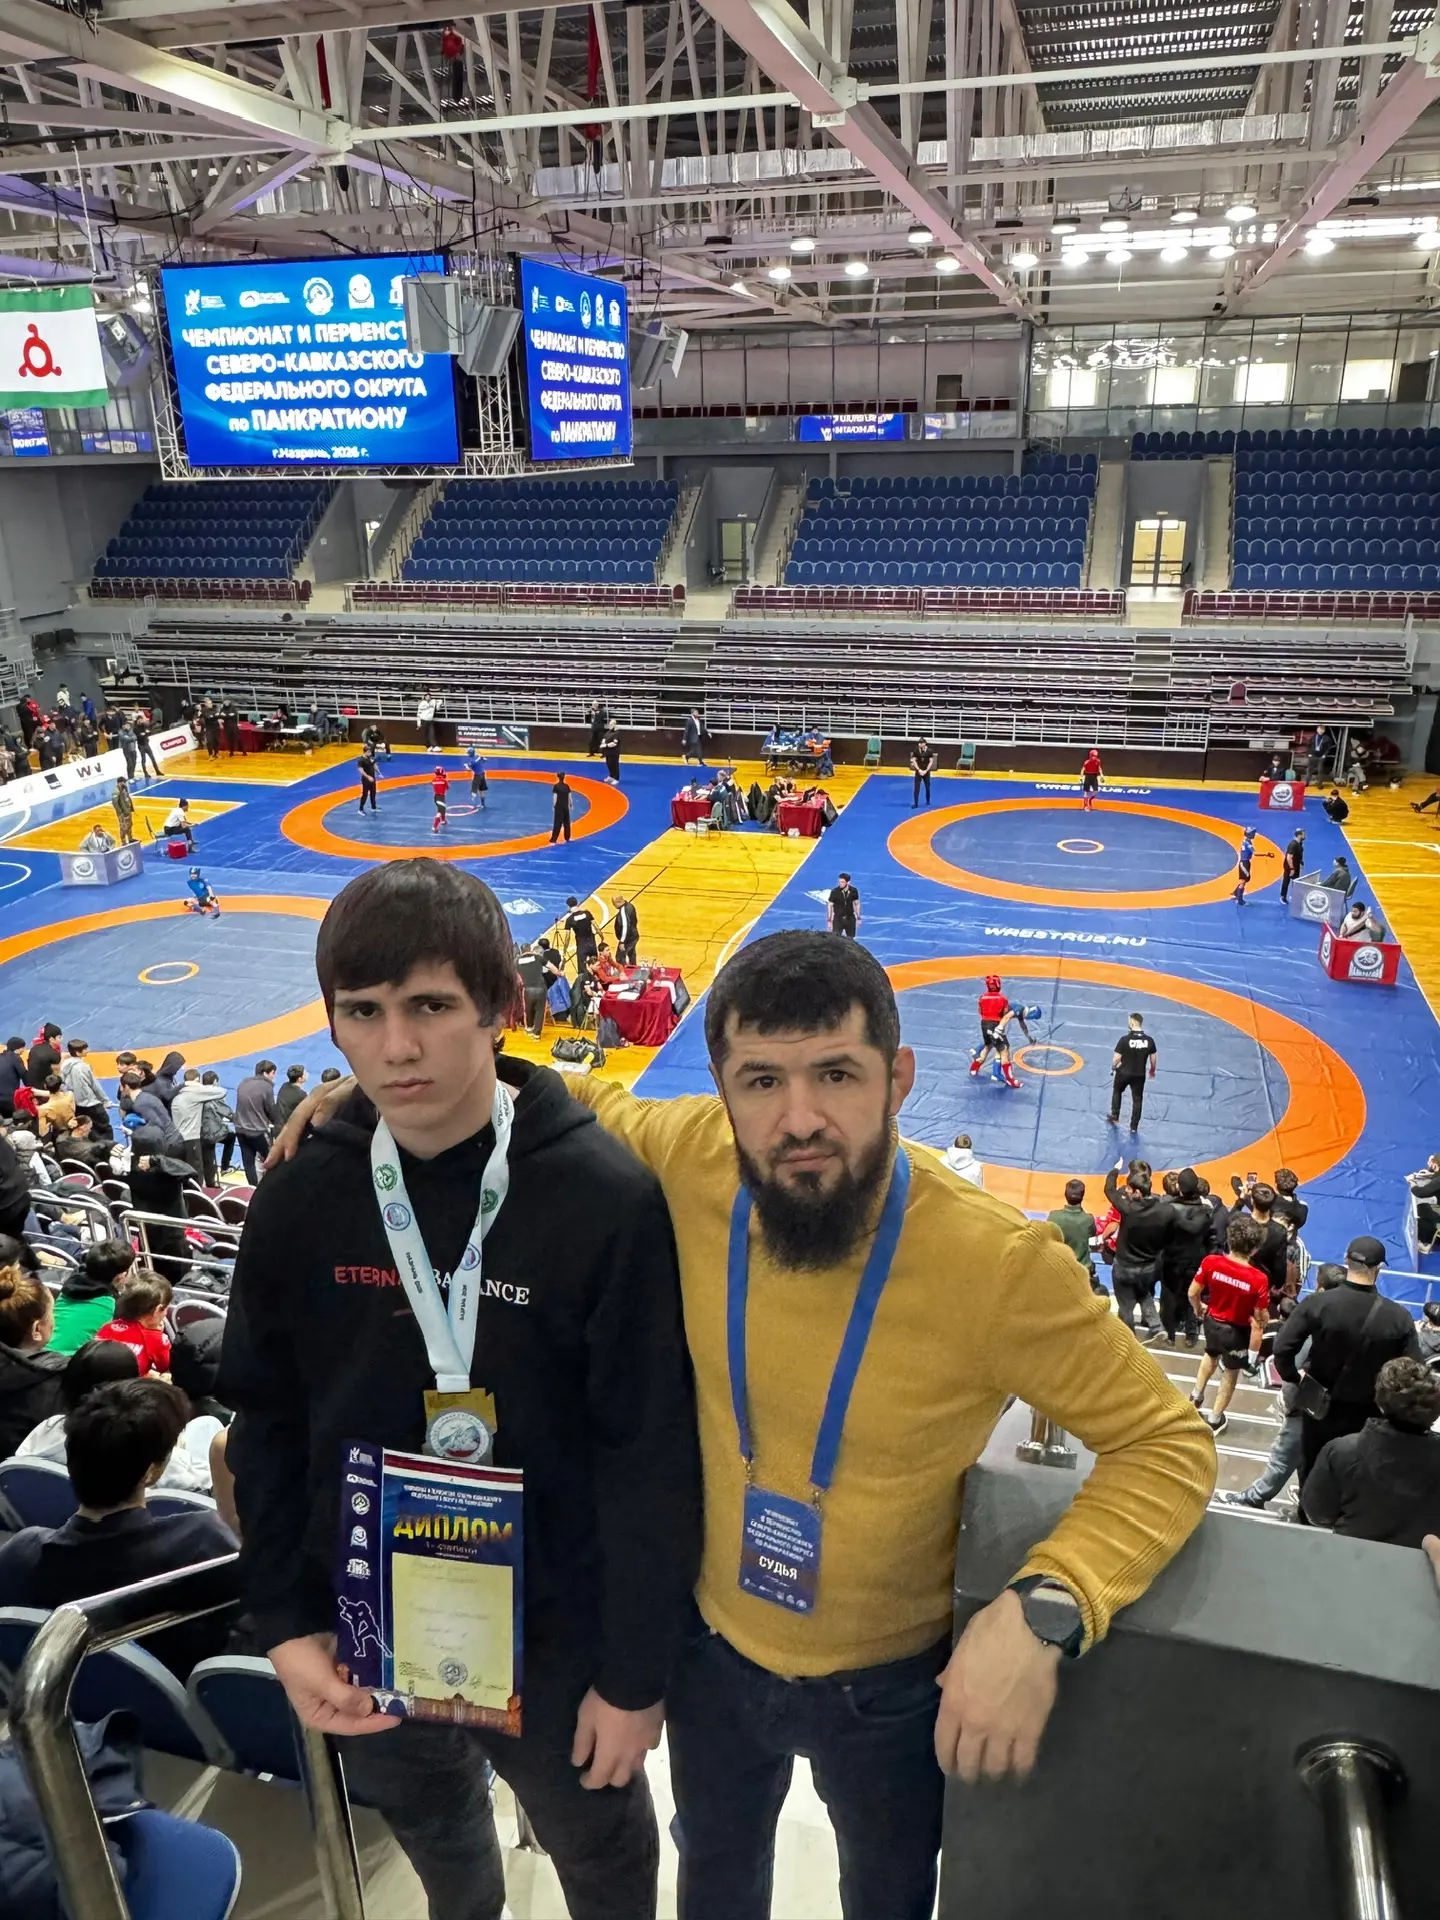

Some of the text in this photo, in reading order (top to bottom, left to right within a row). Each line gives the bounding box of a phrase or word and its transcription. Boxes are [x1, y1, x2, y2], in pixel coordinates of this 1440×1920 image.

[182, 320, 408, 347] ЧЕМПИОНАТ И ПЕРВЕНСТ
[206, 349, 424, 375] СЕВЕРО-КАВКАЗСКОГО
[205, 377, 427, 403] ФЕДЕРАЛЬНОГО ОКРУГА
[251, 406, 408, 431] ПАНКРАТИОНУ
[1035, 783, 1151, 795] WRESUS.RU
[985, 927, 1148, 947] WRESTRUS.RU
[334, 1266, 530, 1305] ETERN BANCE
[393, 1513, 513, 1544] ДИПЛОМ
[759, 1555, 798, 1580] СУДЬЯ
